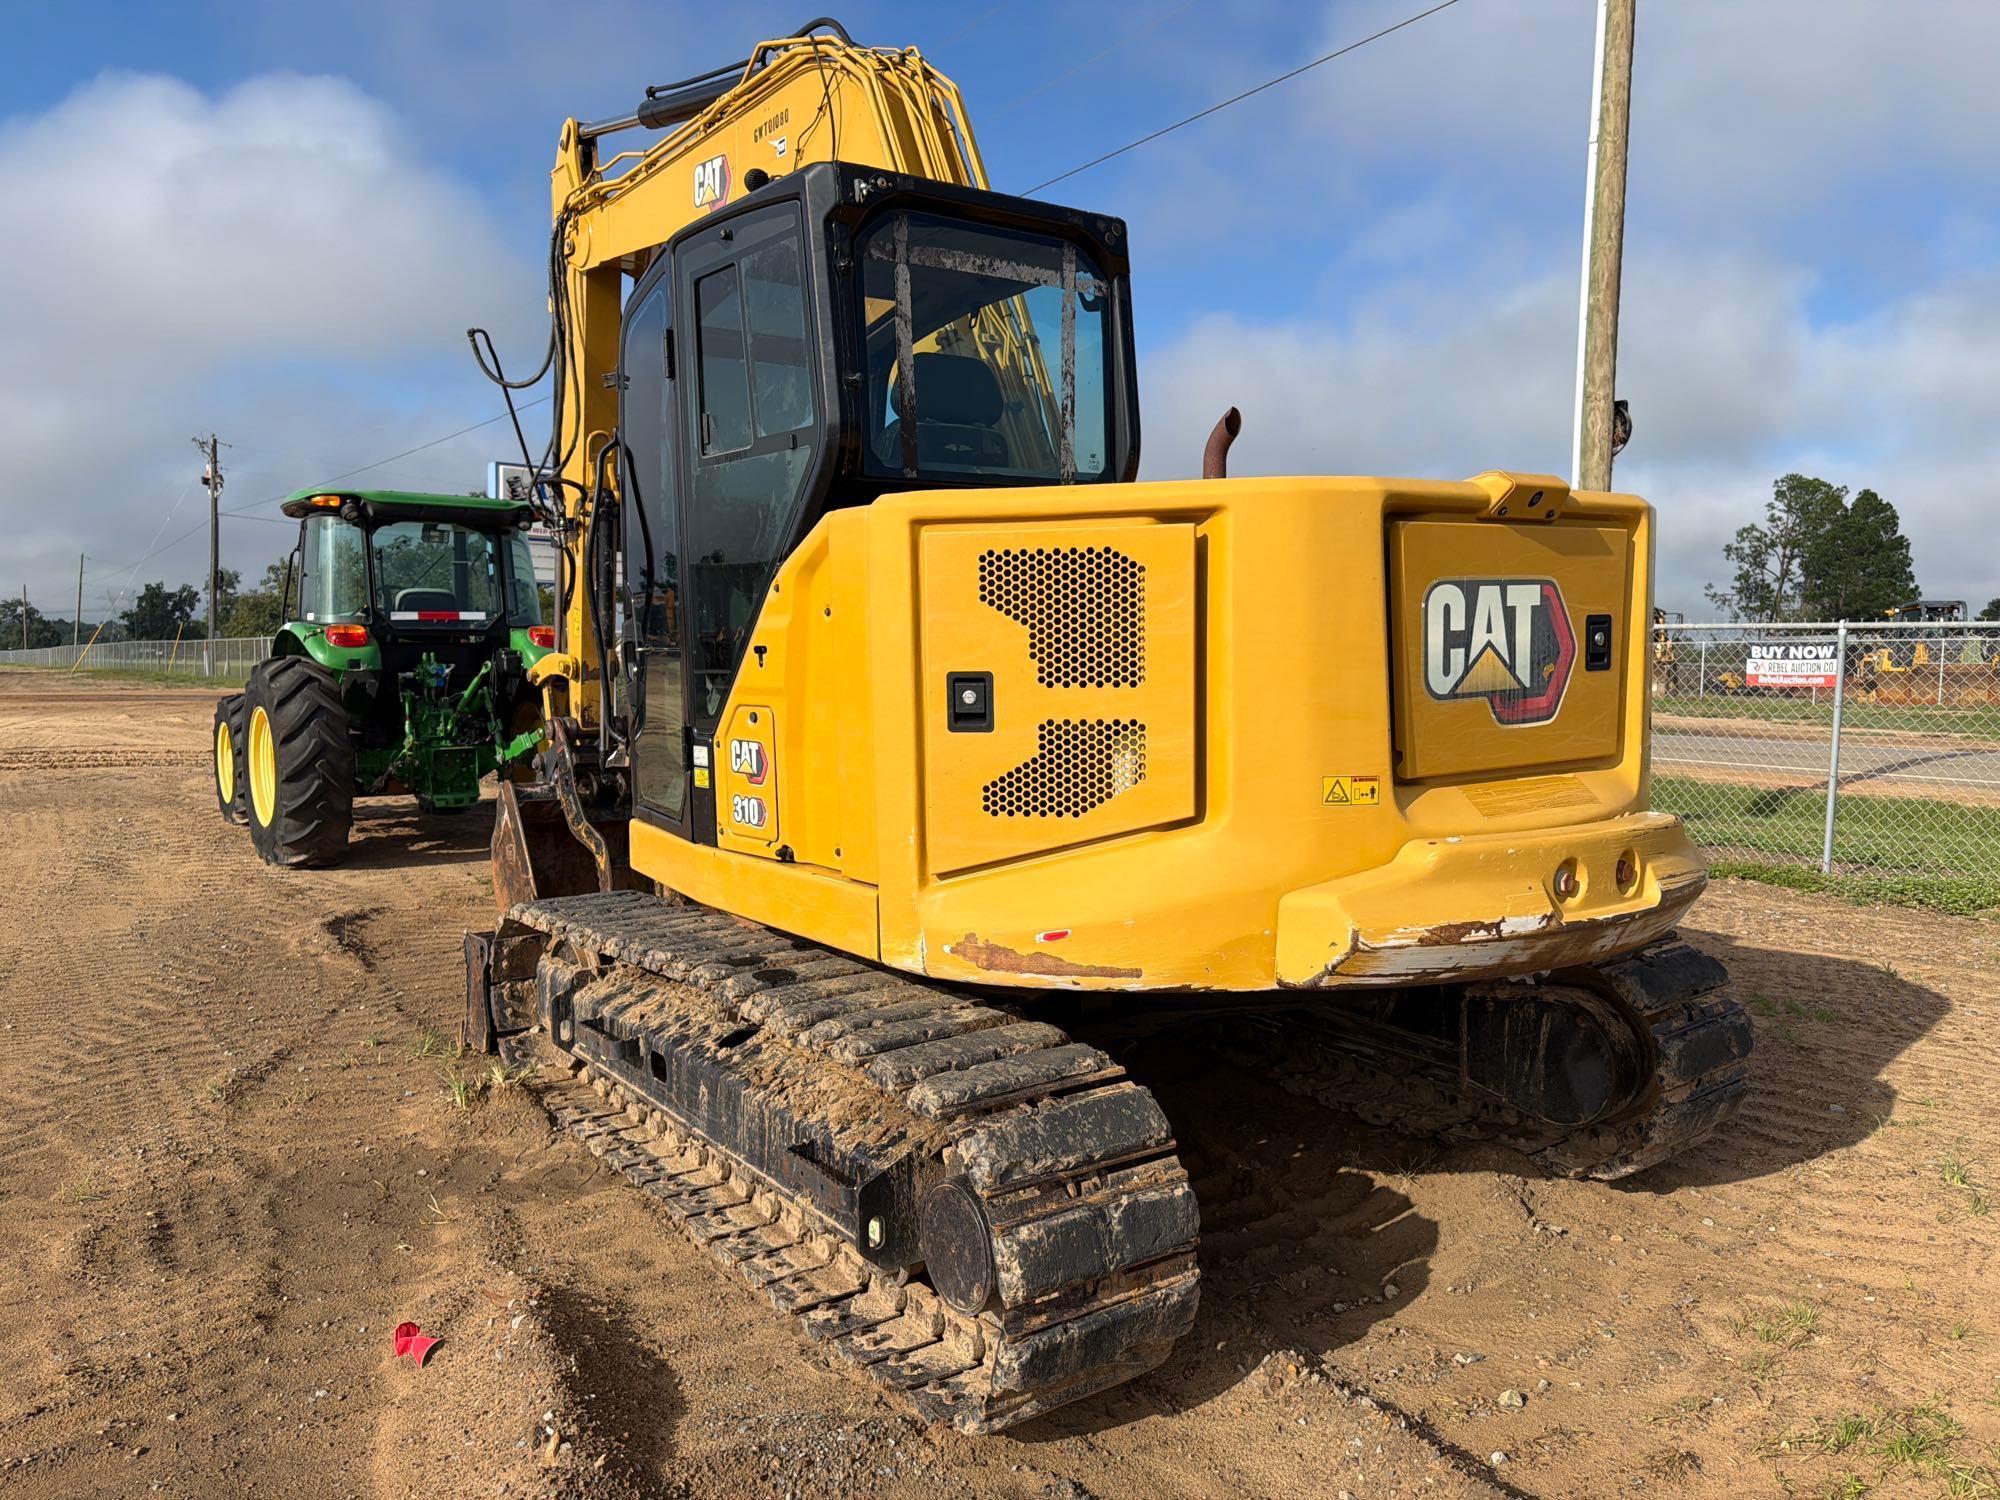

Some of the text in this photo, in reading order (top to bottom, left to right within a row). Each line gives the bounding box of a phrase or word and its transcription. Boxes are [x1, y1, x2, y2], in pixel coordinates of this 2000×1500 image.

[694, 156, 723, 207] CAT
[1427, 584, 1541, 695] CAT
[1751, 645, 1834, 659] BUY NOW
[1768, 662, 1788, 673] REBEL
[1791, 662, 1822, 673] AUCTION
[731, 740, 759, 774] CAT
[733, 795, 759, 825] 310
